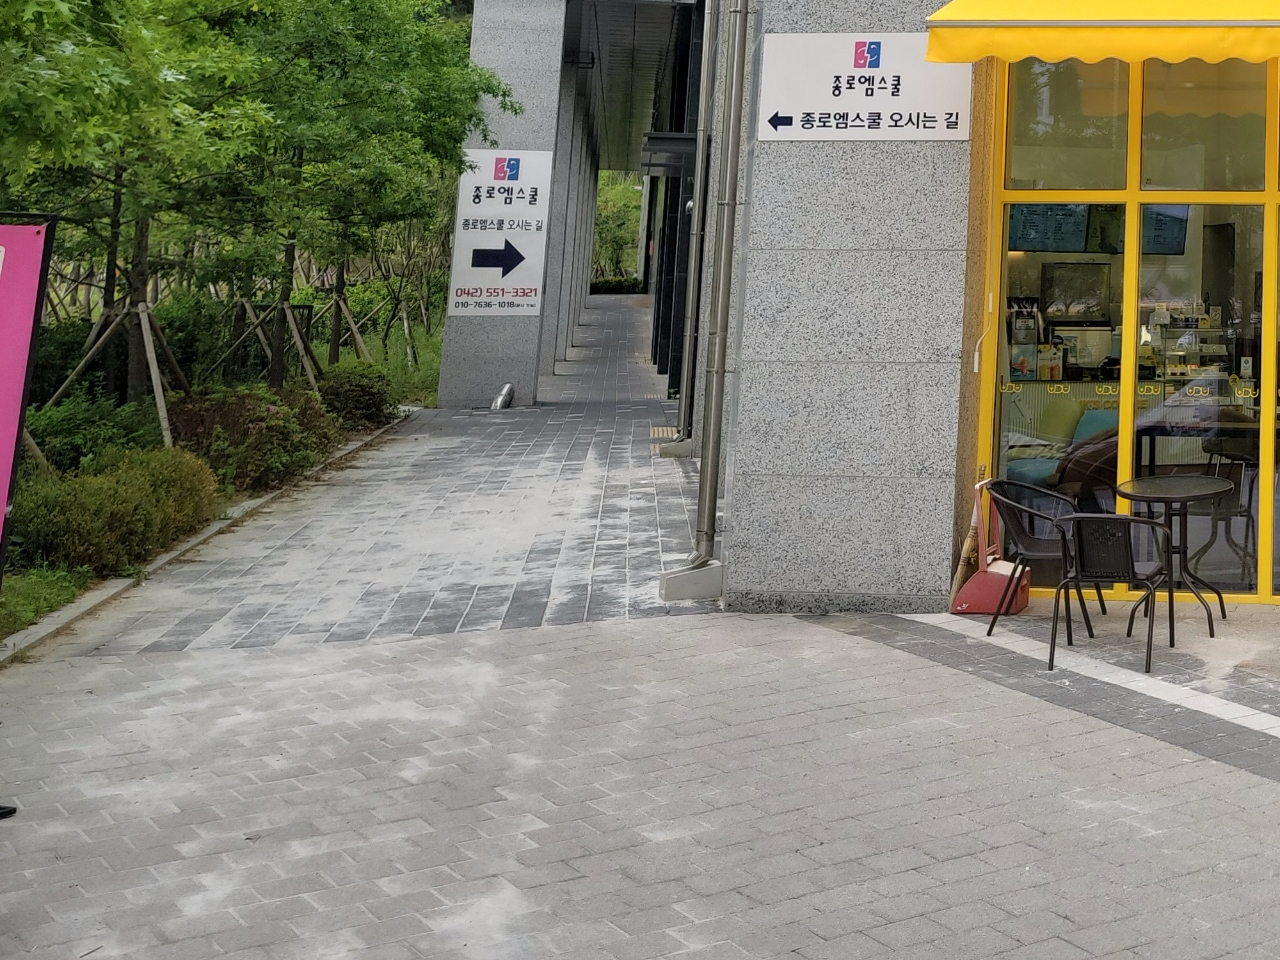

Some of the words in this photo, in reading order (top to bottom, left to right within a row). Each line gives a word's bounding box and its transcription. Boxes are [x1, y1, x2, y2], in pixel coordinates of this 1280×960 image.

[831, 75, 902, 98] 종로엠스쿨
[799, 112, 883, 130] 종로엠스쿨
[887, 112, 938, 130] 오시는
[944, 112, 960, 130] 길
[472, 185, 539, 206] 종로엠스쿨
[462, 218, 505, 231] 종로엠스쿨
[507, 219, 533, 231] 오시는
[535, 219, 544, 232] 길
[455, 287, 483, 298] 042)
[485, 287, 538, 298] 551-3321
